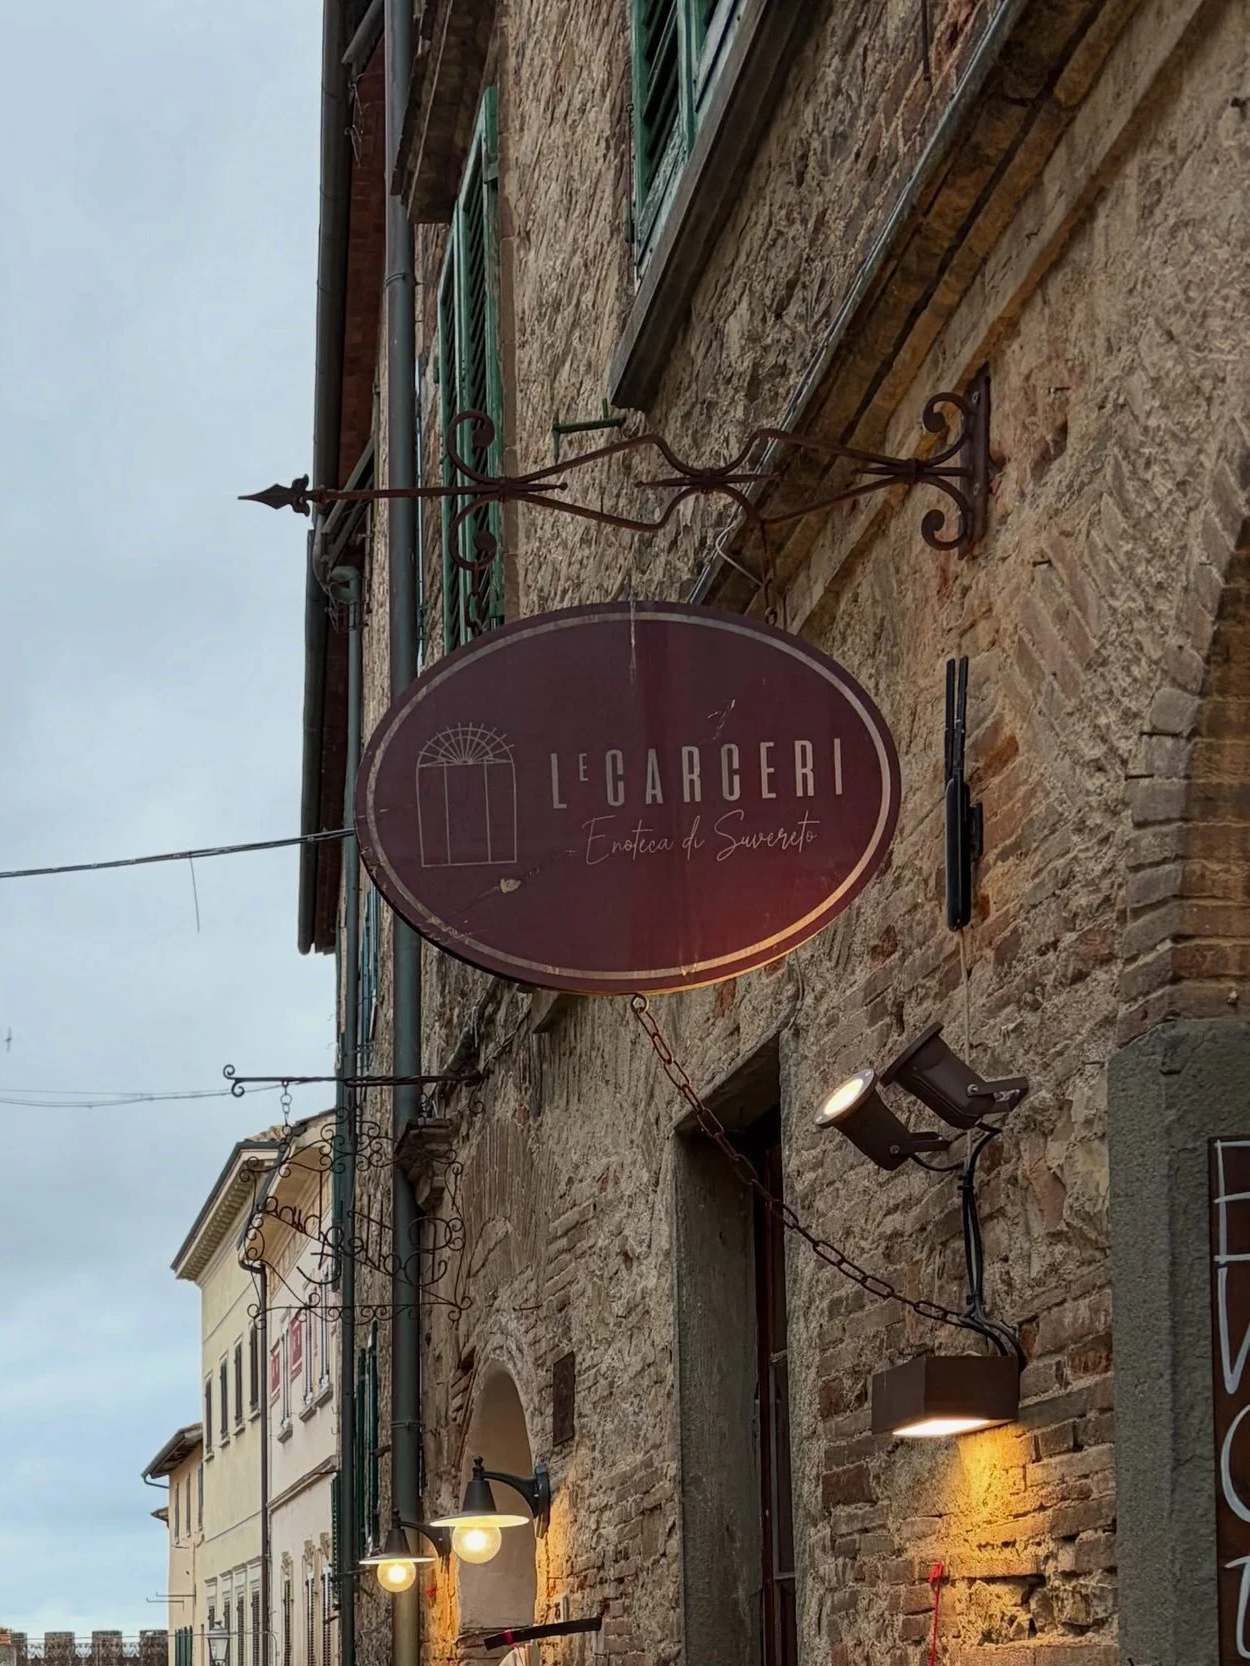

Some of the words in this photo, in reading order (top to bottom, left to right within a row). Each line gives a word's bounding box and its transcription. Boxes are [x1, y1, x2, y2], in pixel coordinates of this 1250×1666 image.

[605, 738, 843, 807] CARCERI
[582, 814, 674, 865] Enoteca
[682, 815, 706, 860] di
[714, 809, 820, 862] Suvereto
